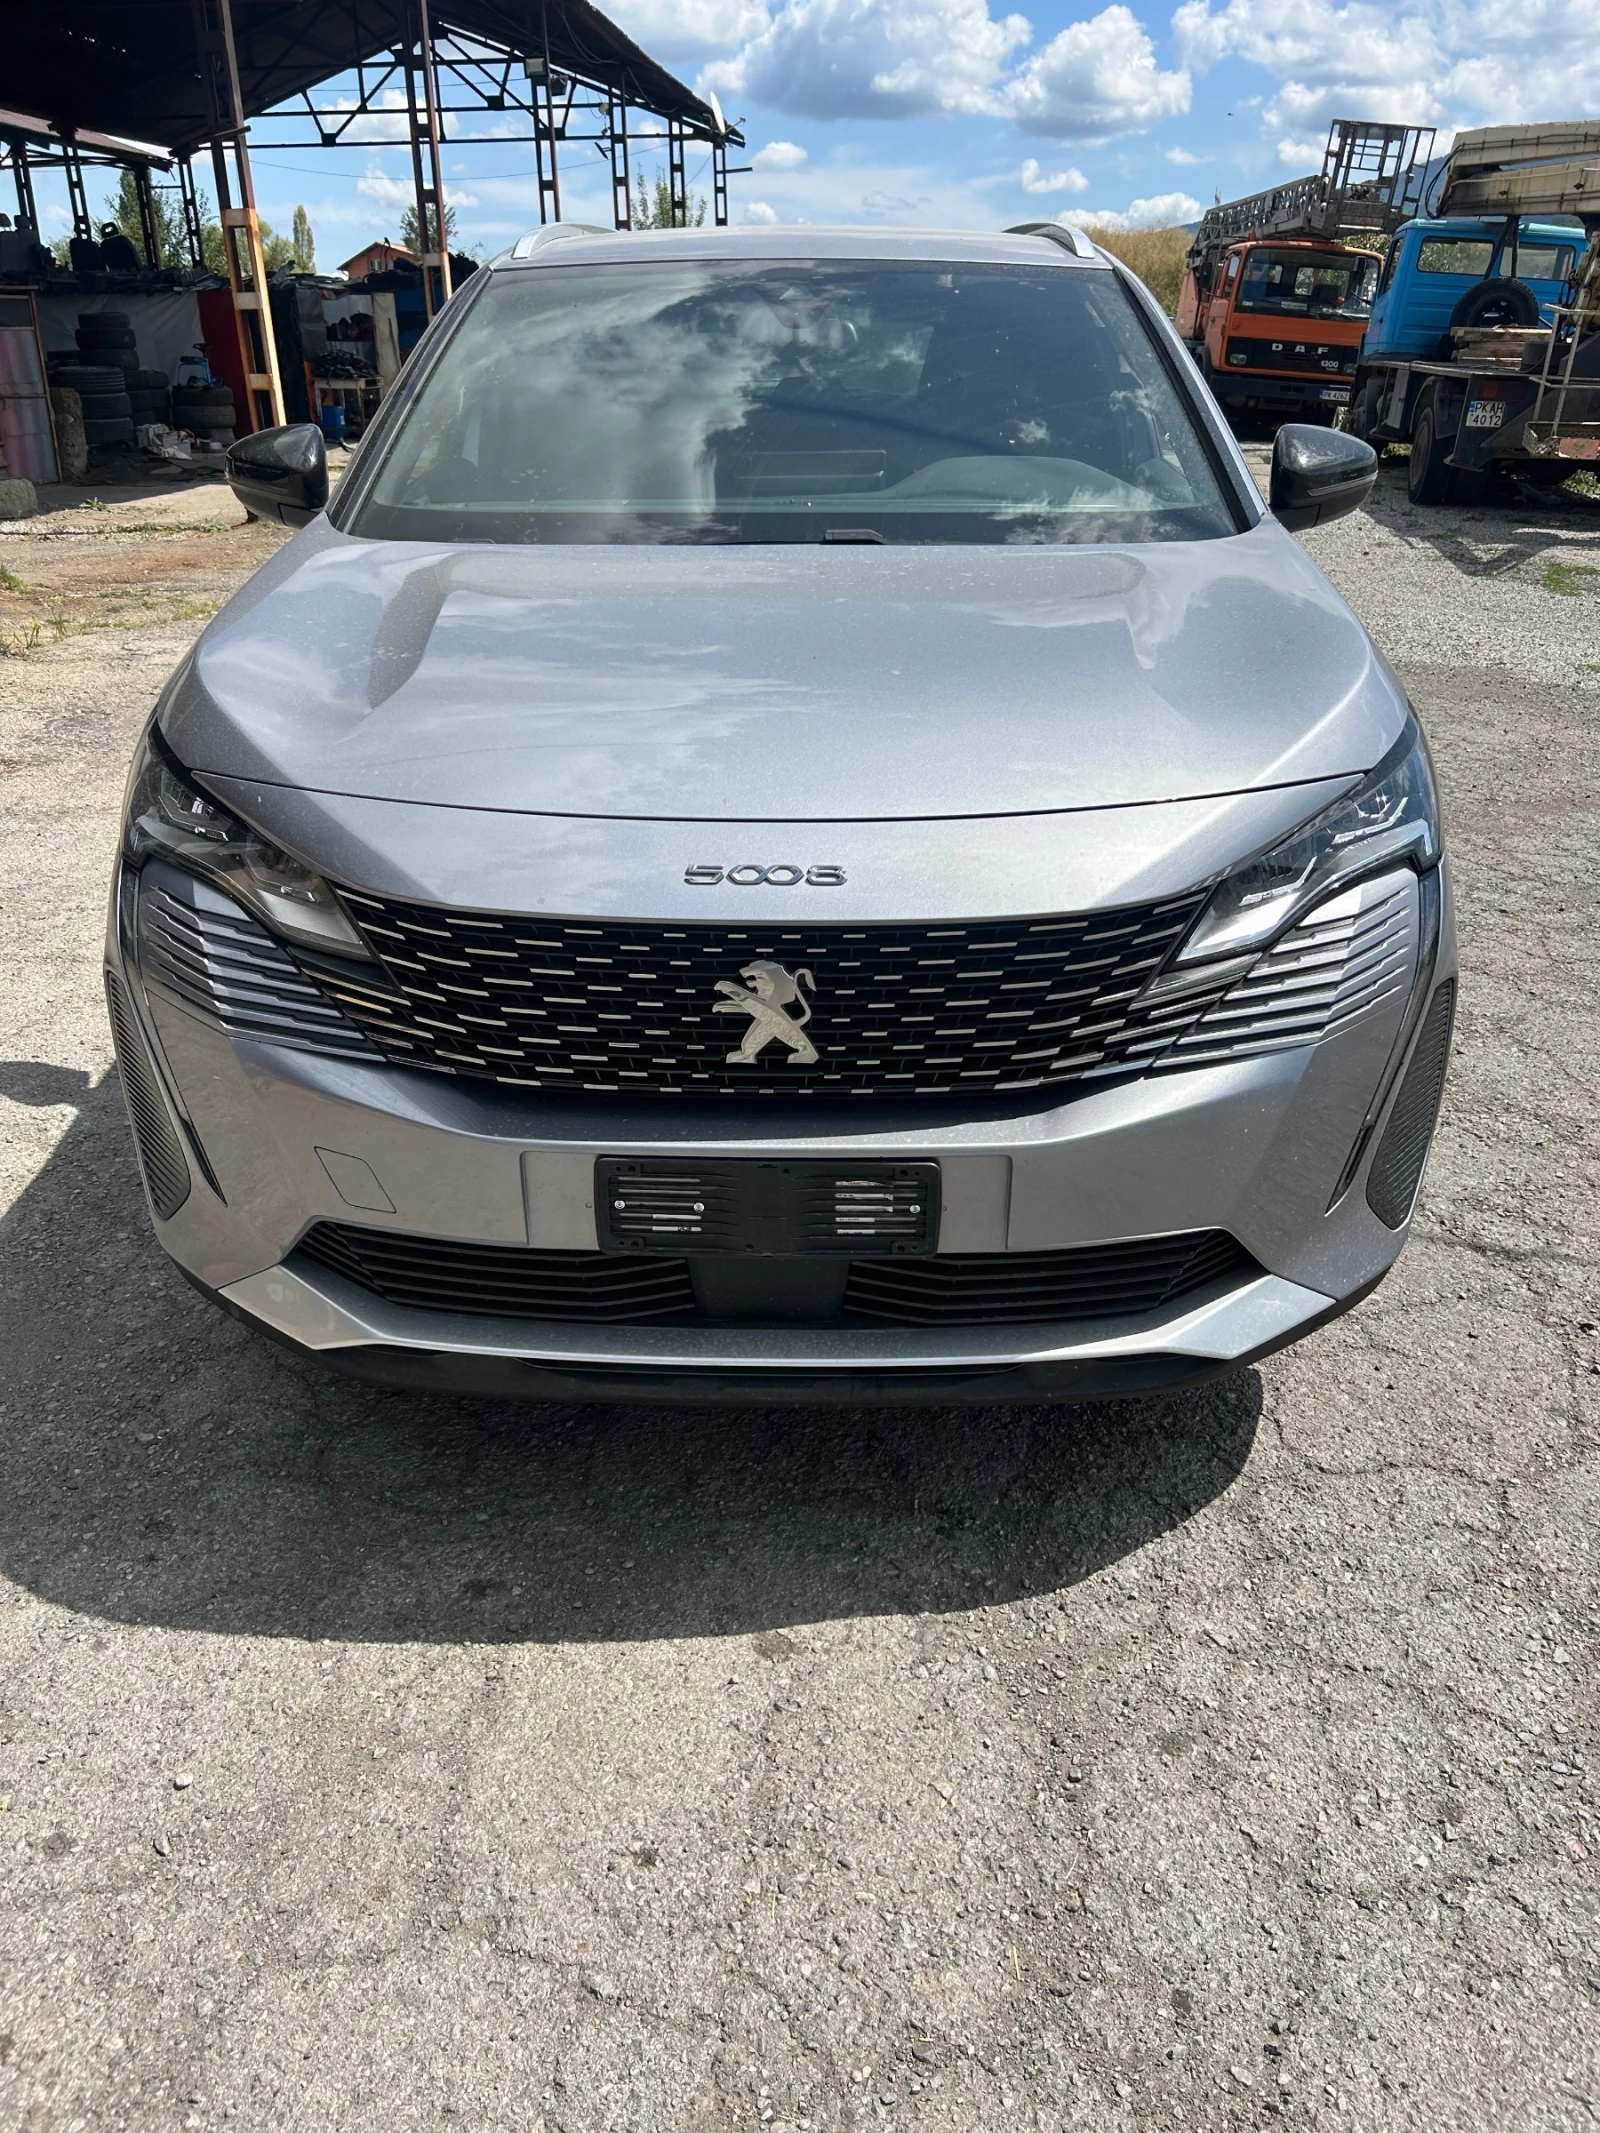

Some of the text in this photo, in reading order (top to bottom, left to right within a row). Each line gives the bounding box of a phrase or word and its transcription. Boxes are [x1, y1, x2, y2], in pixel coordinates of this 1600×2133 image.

[1320, 360, 1338, 368] 1300
[1473, 414, 1501, 426] 4012
[684, 863, 848, 886] 5008
